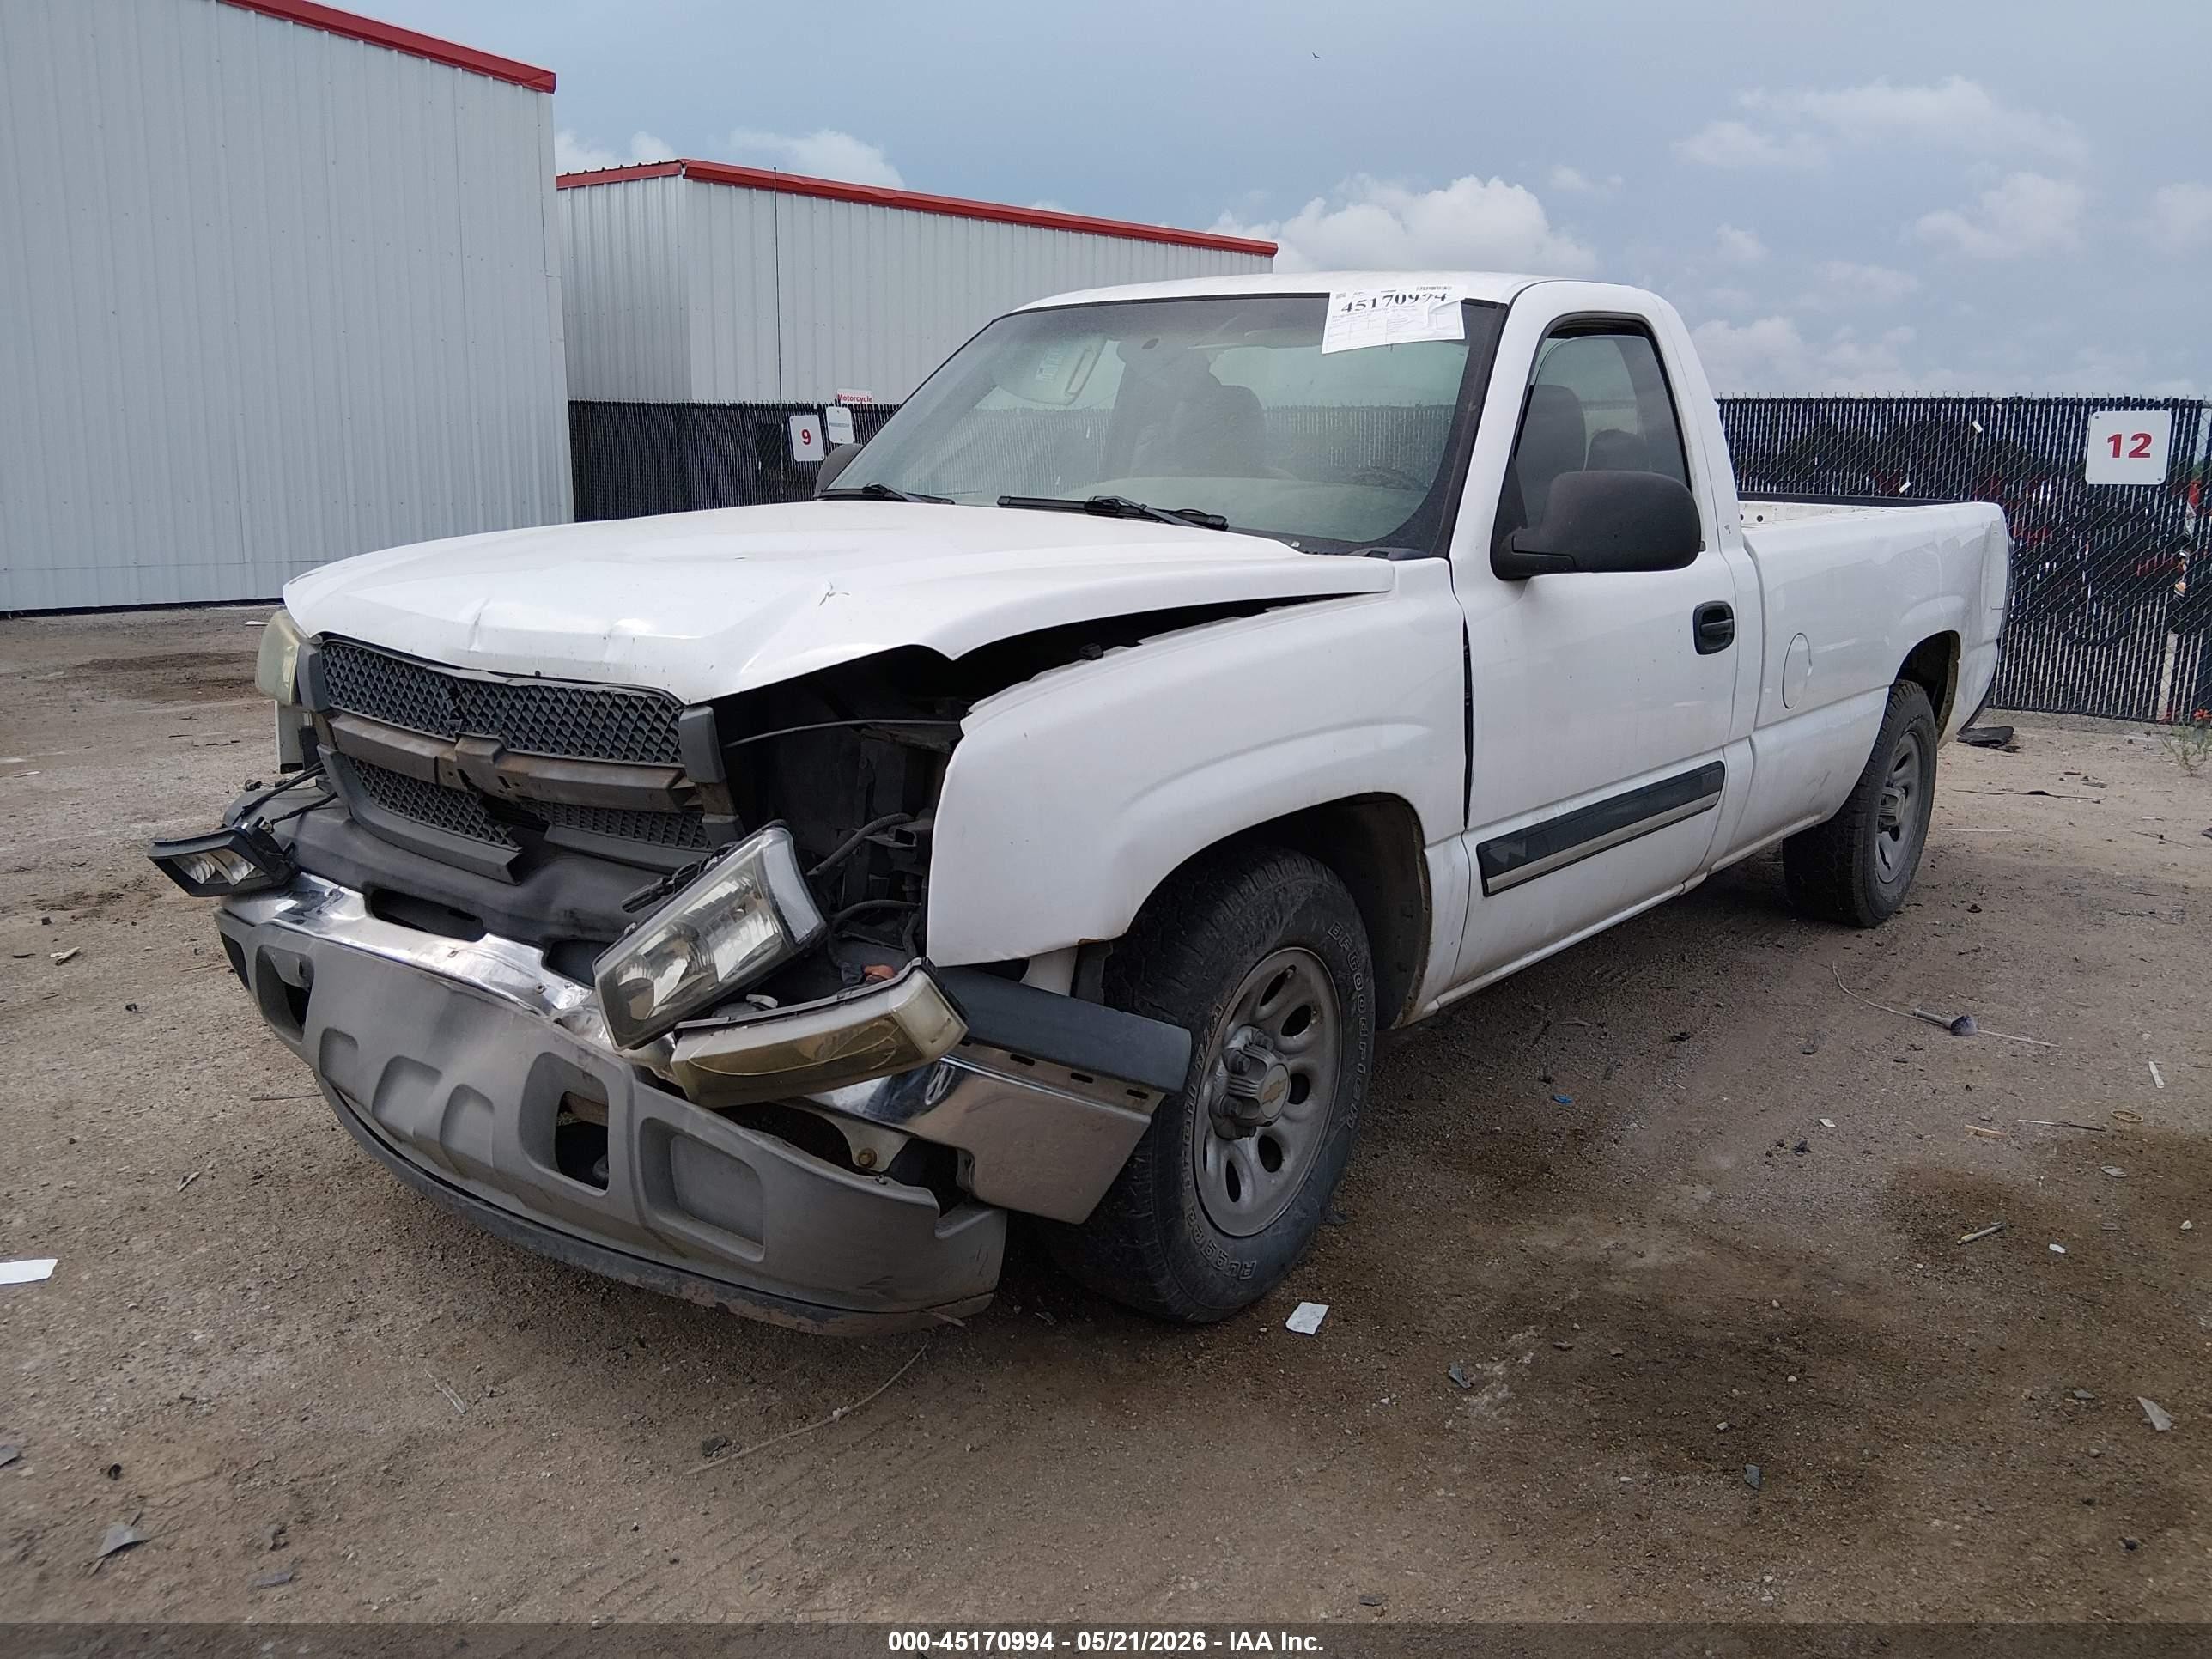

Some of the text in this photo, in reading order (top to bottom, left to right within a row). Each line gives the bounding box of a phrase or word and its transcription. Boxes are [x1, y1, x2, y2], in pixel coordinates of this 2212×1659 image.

[837, 394, 873, 404] Motorcycle
[801, 429, 811, 445] 9
[2107, 433, 2152, 458] 12
